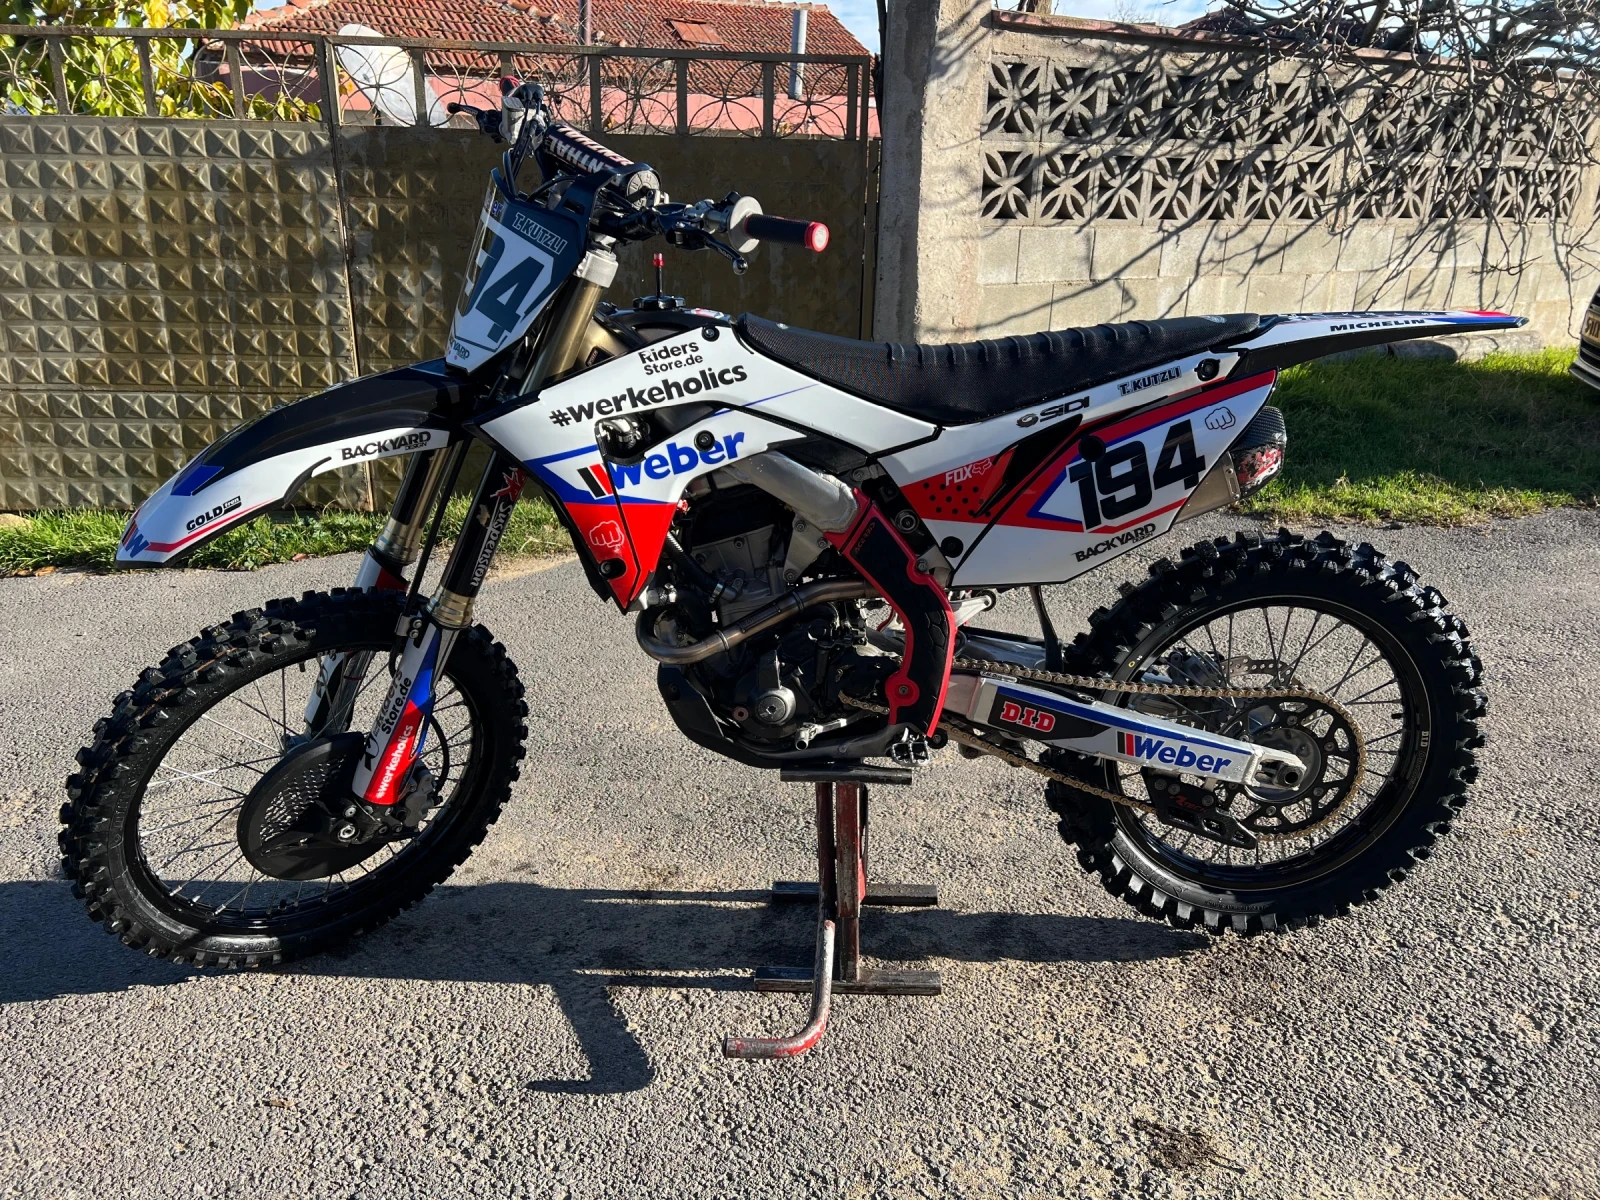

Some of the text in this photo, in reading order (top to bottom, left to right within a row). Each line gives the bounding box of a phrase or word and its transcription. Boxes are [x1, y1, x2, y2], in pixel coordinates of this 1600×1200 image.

[1329, 319, 1425, 332] MICHELIN
[637, 341, 700, 365] Riders
[643, 354, 704, 376] Store.de
[549, 364, 748, 428] #werkeholics
[1040, 396, 1090, 422] SIDI
[341, 430, 431, 460] BACKYARD
[609, 431, 745, 490] Weber
[944, 463, 973, 487] FOX
[1069, 418, 1206, 532] 194
[470, 501, 513, 587] Suspension
[1073, 522, 1156, 562] BACKYARD
[381, 677, 412, 735] Store.de
[1134, 735, 1232, 774] Weber
